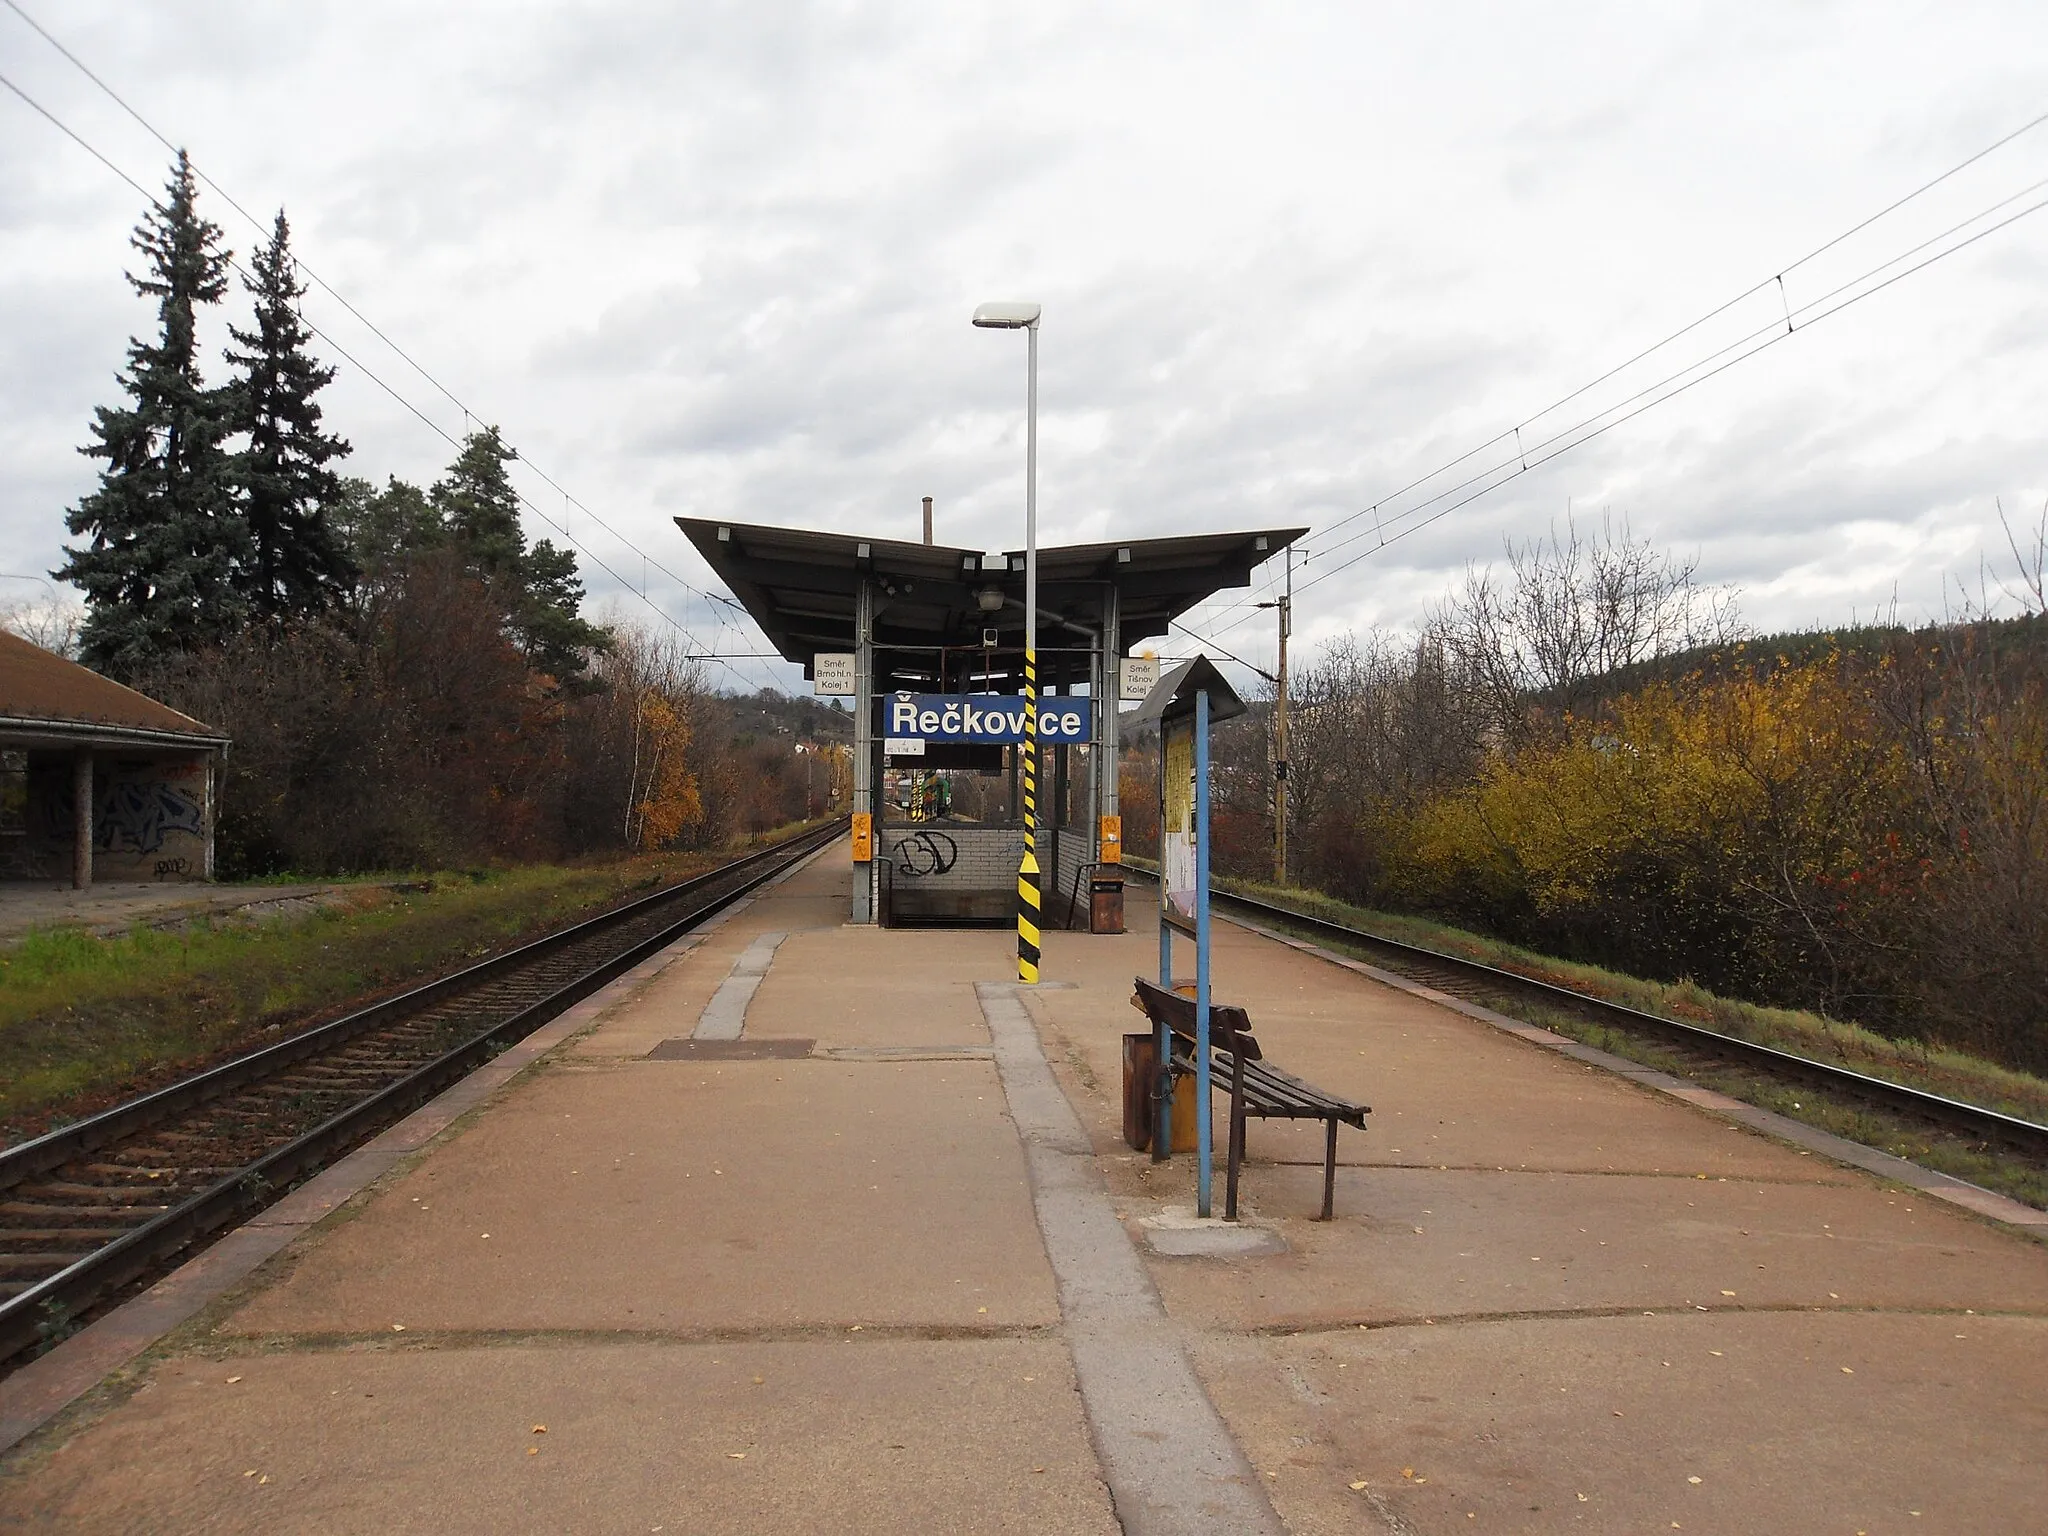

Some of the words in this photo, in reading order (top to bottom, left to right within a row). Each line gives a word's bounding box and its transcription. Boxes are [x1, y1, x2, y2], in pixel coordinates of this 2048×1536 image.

[823, 660, 846, 668] Směr
[1129, 665, 1151, 673] Směr
[1127, 675, 1153, 683] Tišnov
[821, 681, 842, 690] Kolej
[844, 681, 849, 689] 1
[1126, 685, 1147, 695] Kolej
[893, 694, 1081, 736] Řečkovce
